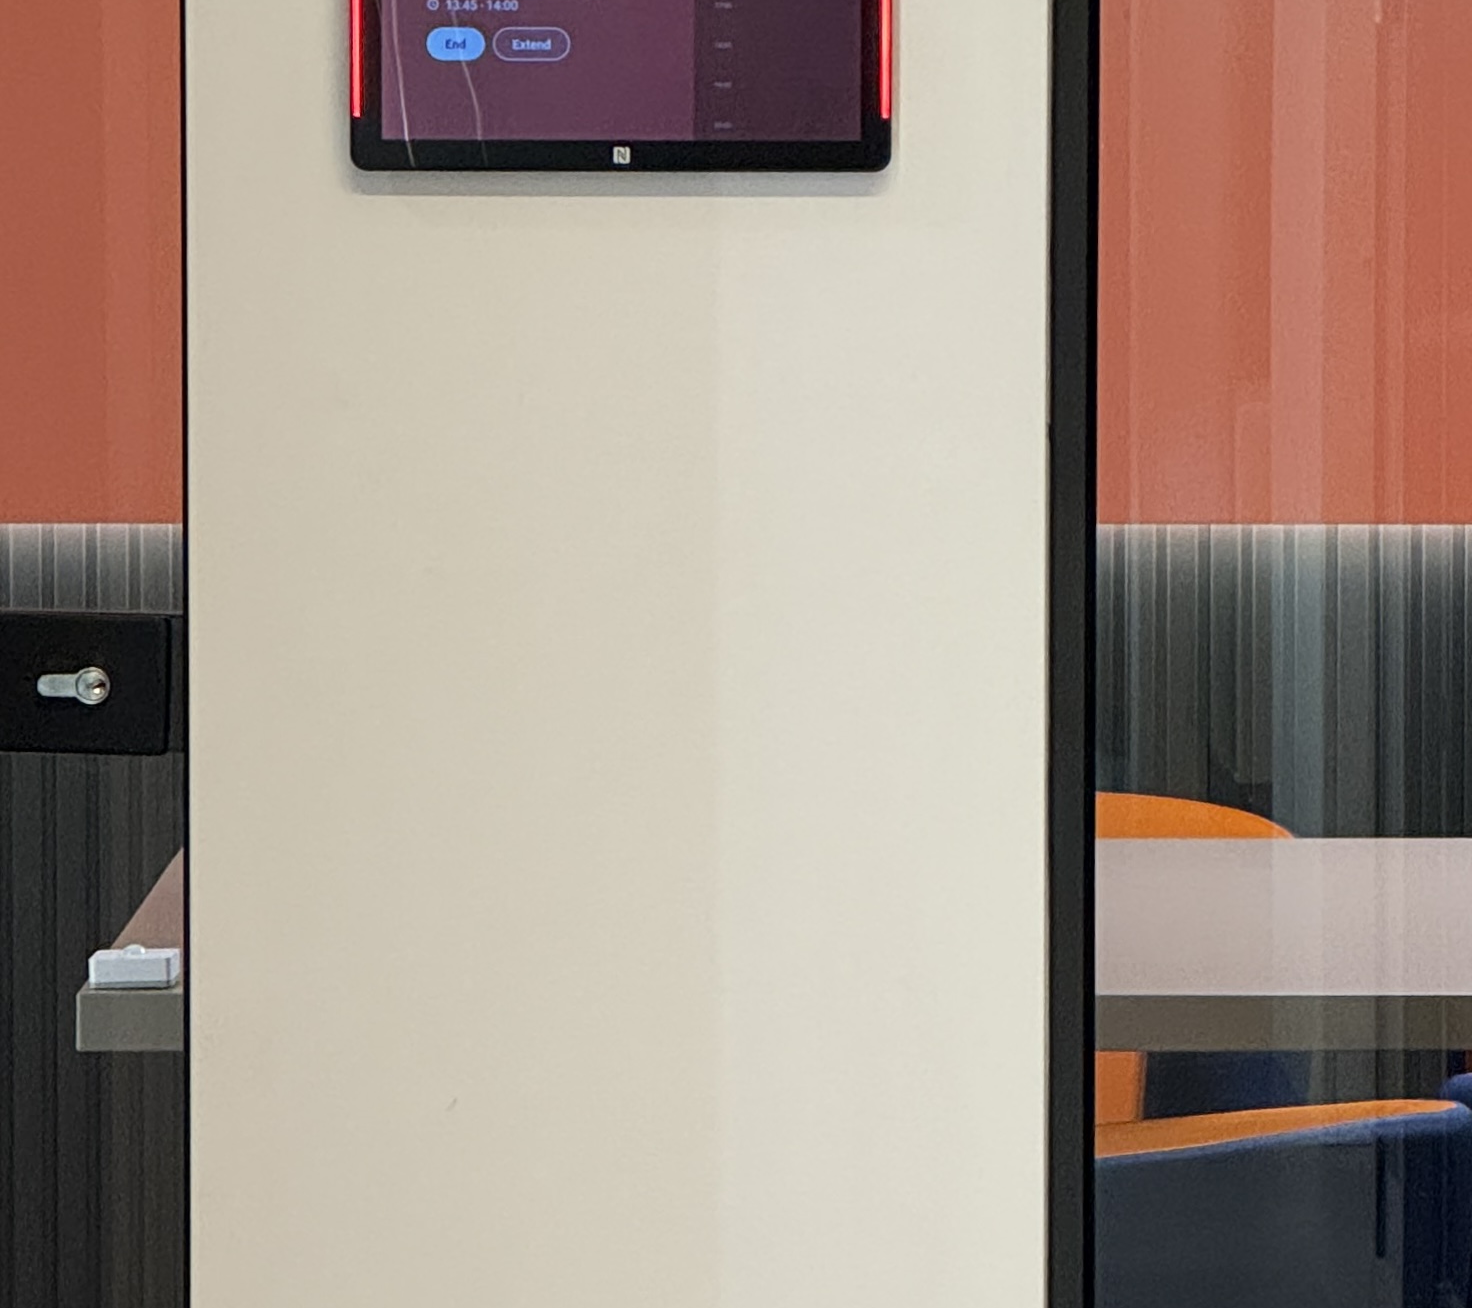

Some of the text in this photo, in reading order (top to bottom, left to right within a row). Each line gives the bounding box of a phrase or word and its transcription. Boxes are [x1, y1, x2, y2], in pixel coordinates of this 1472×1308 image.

[446, 0, 478, 12] 13:45
[487, 0, 519, 12] 14:00
[445, 38, 552, 51] End Extend
